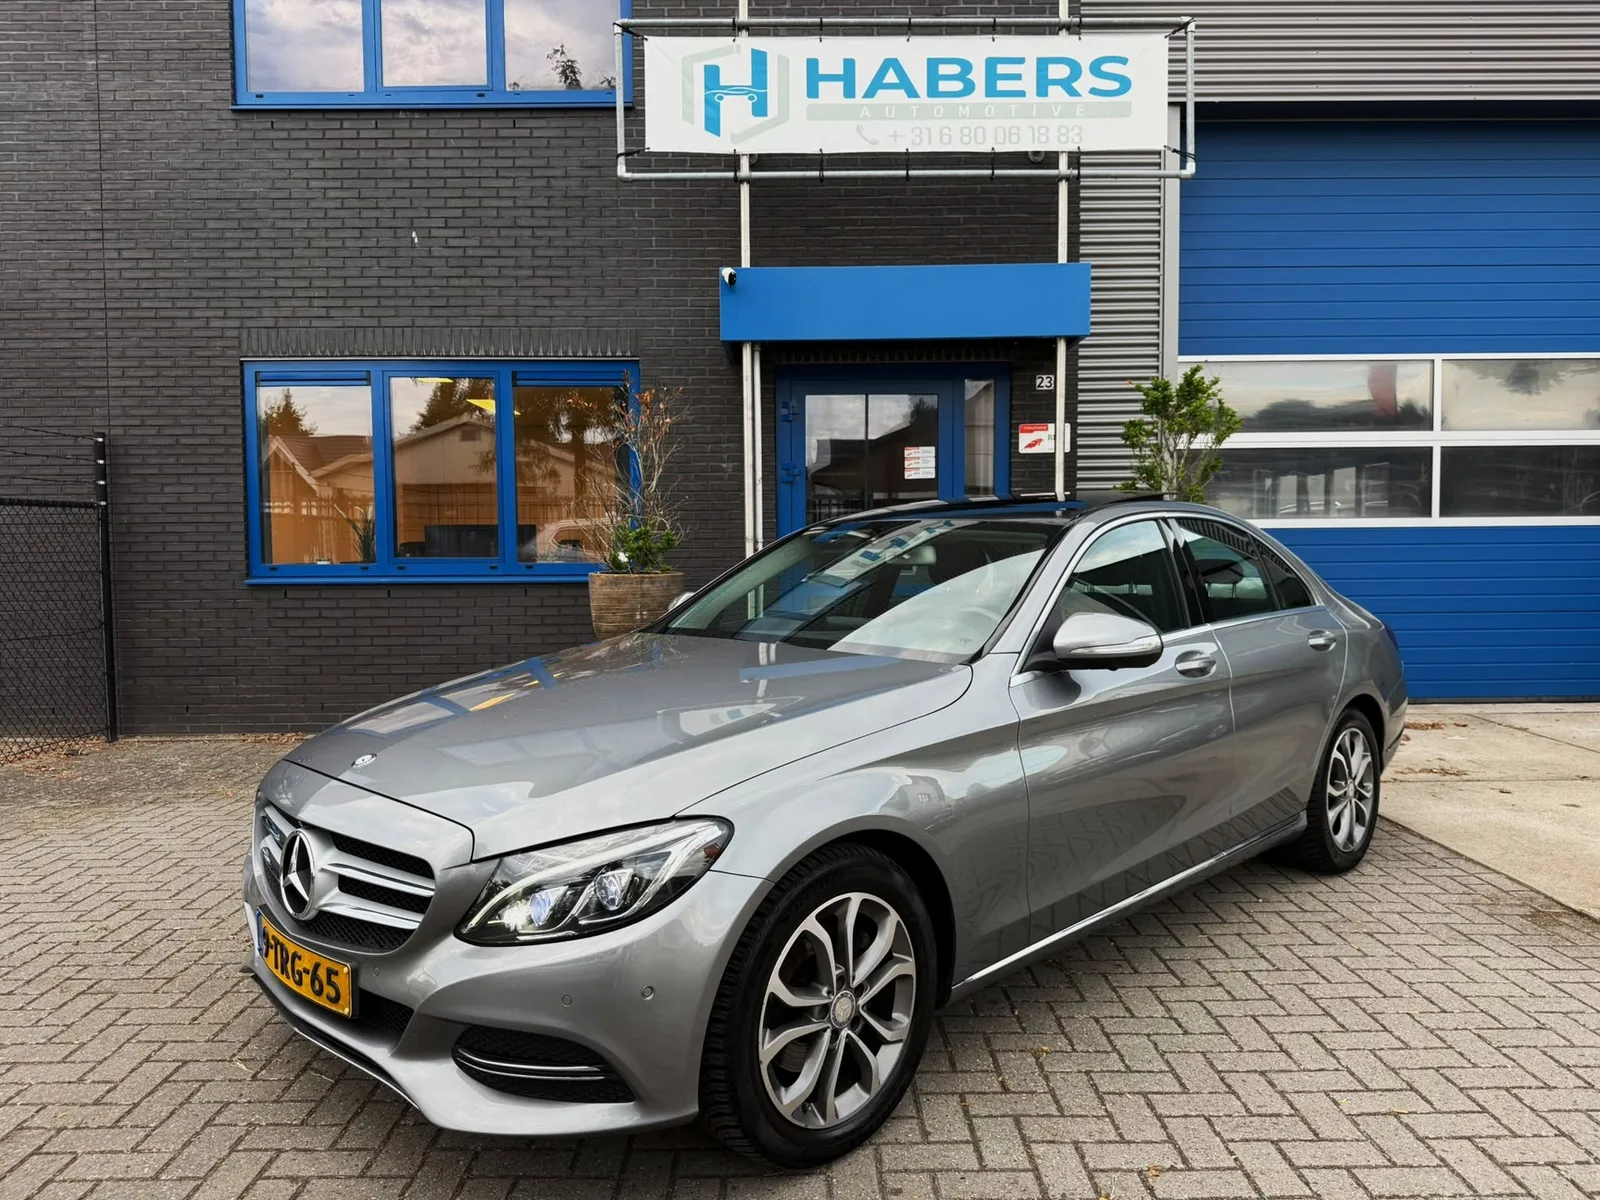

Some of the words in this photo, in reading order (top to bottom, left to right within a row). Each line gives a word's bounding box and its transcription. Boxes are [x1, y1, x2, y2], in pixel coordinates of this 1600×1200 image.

[806, 55, 1132, 99] HABERS
[860, 103, 1085, 119] AUTOMOTIVE
[960, 126, 986, 145] 80
[994, 125, 1021, 145] 06
[1028, 125, 1050, 145] 18
[1057, 125, 1083, 145] 83
[1037, 376, 1053, 389] 23
